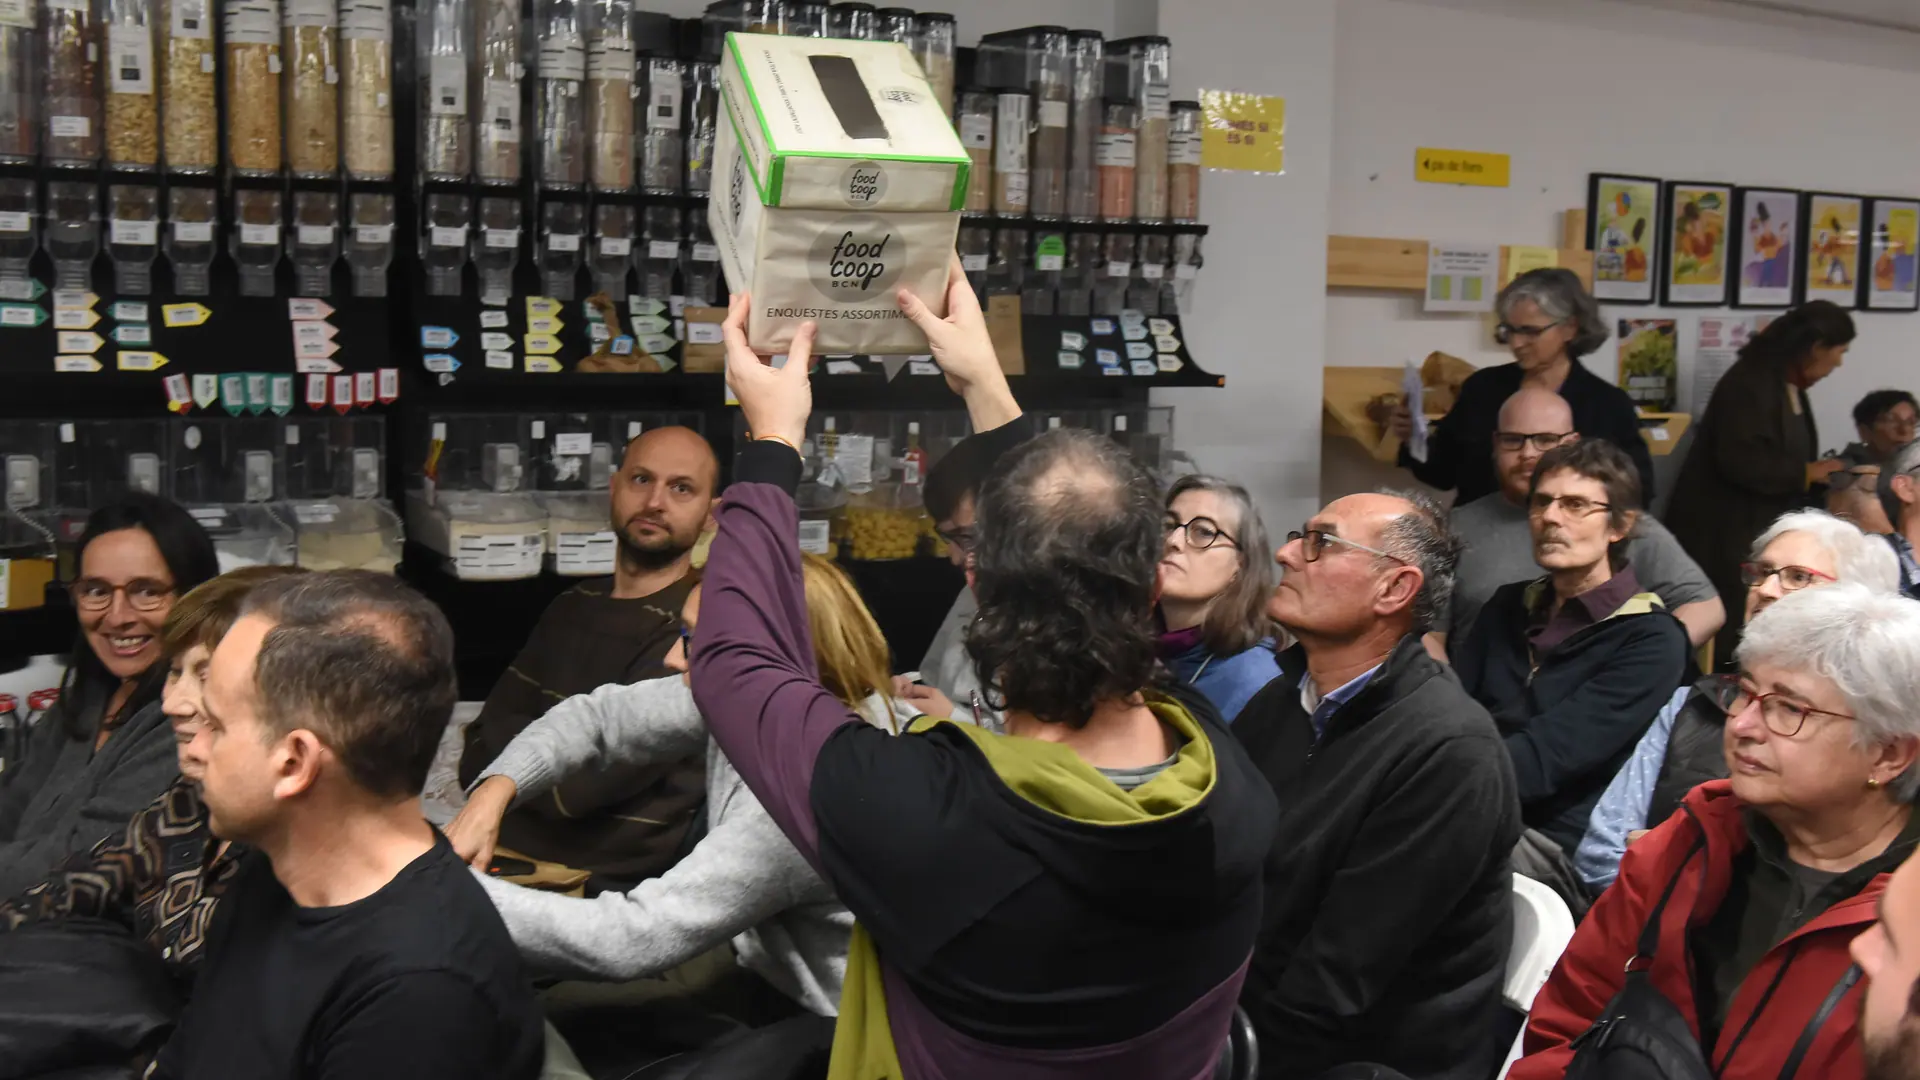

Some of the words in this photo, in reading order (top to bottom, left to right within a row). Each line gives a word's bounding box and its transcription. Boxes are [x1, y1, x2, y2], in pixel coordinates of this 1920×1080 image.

[851, 169, 880, 187] food
[851, 185, 877, 200] coop
[830, 231, 890, 266] food
[830, 260, 884, 290] coop
[832, 280, 859, 288] BCN
[767, 307, 838, 319] ENQUESTES
[841, 309, 908, 320] ASSORTIM
